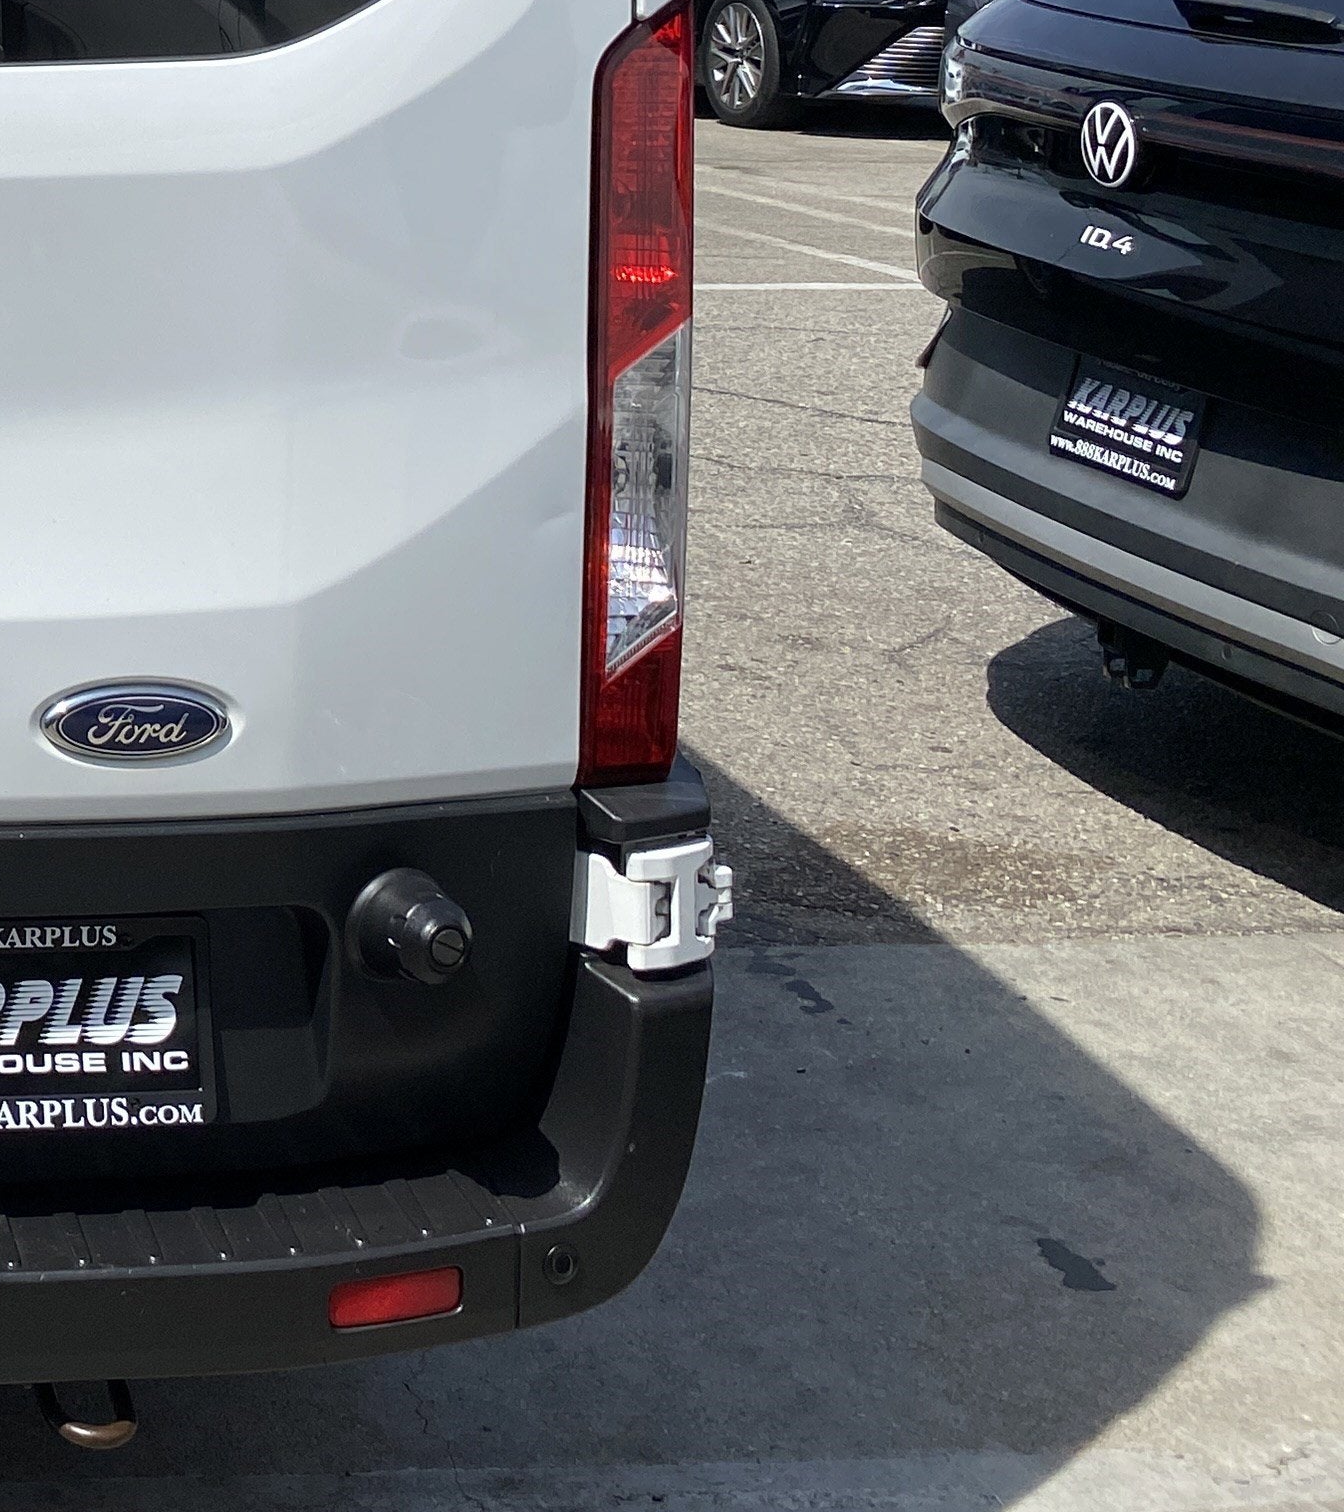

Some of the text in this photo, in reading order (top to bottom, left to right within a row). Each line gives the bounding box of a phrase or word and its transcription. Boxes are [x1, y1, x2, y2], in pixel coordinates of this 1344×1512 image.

[1068, 375, 1194, 446] KARPLUS
[1062, 409, 1184, 465] WAREHOUSE INC
[86, 702, 190, 746] Ford
[121, 1050, 189, 1073] INC
